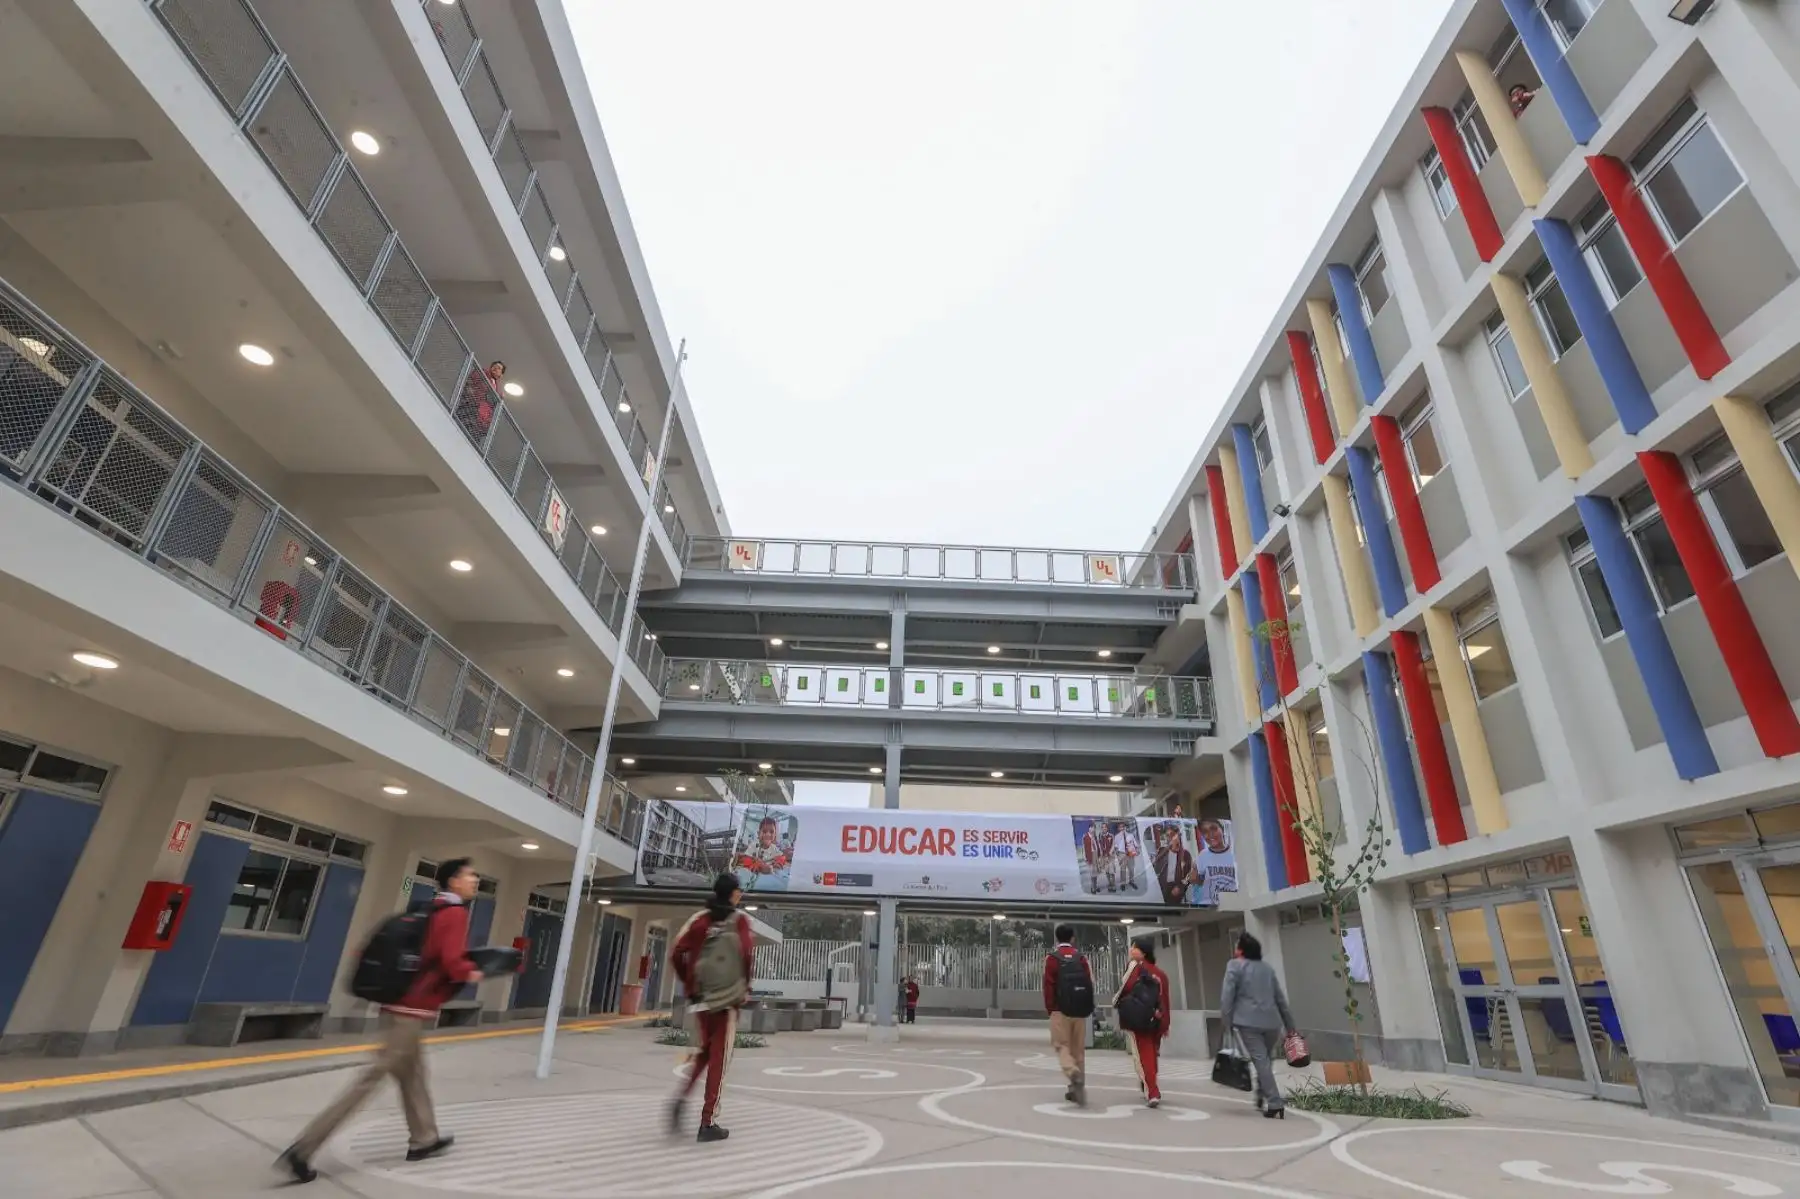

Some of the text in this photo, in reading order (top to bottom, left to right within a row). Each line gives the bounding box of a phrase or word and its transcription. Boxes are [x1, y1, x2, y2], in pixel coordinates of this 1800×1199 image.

[841, 825, 956, 857] EDUCAR
[963, 829, 979, 842] ES
[963, 844, 979, 858] ES
